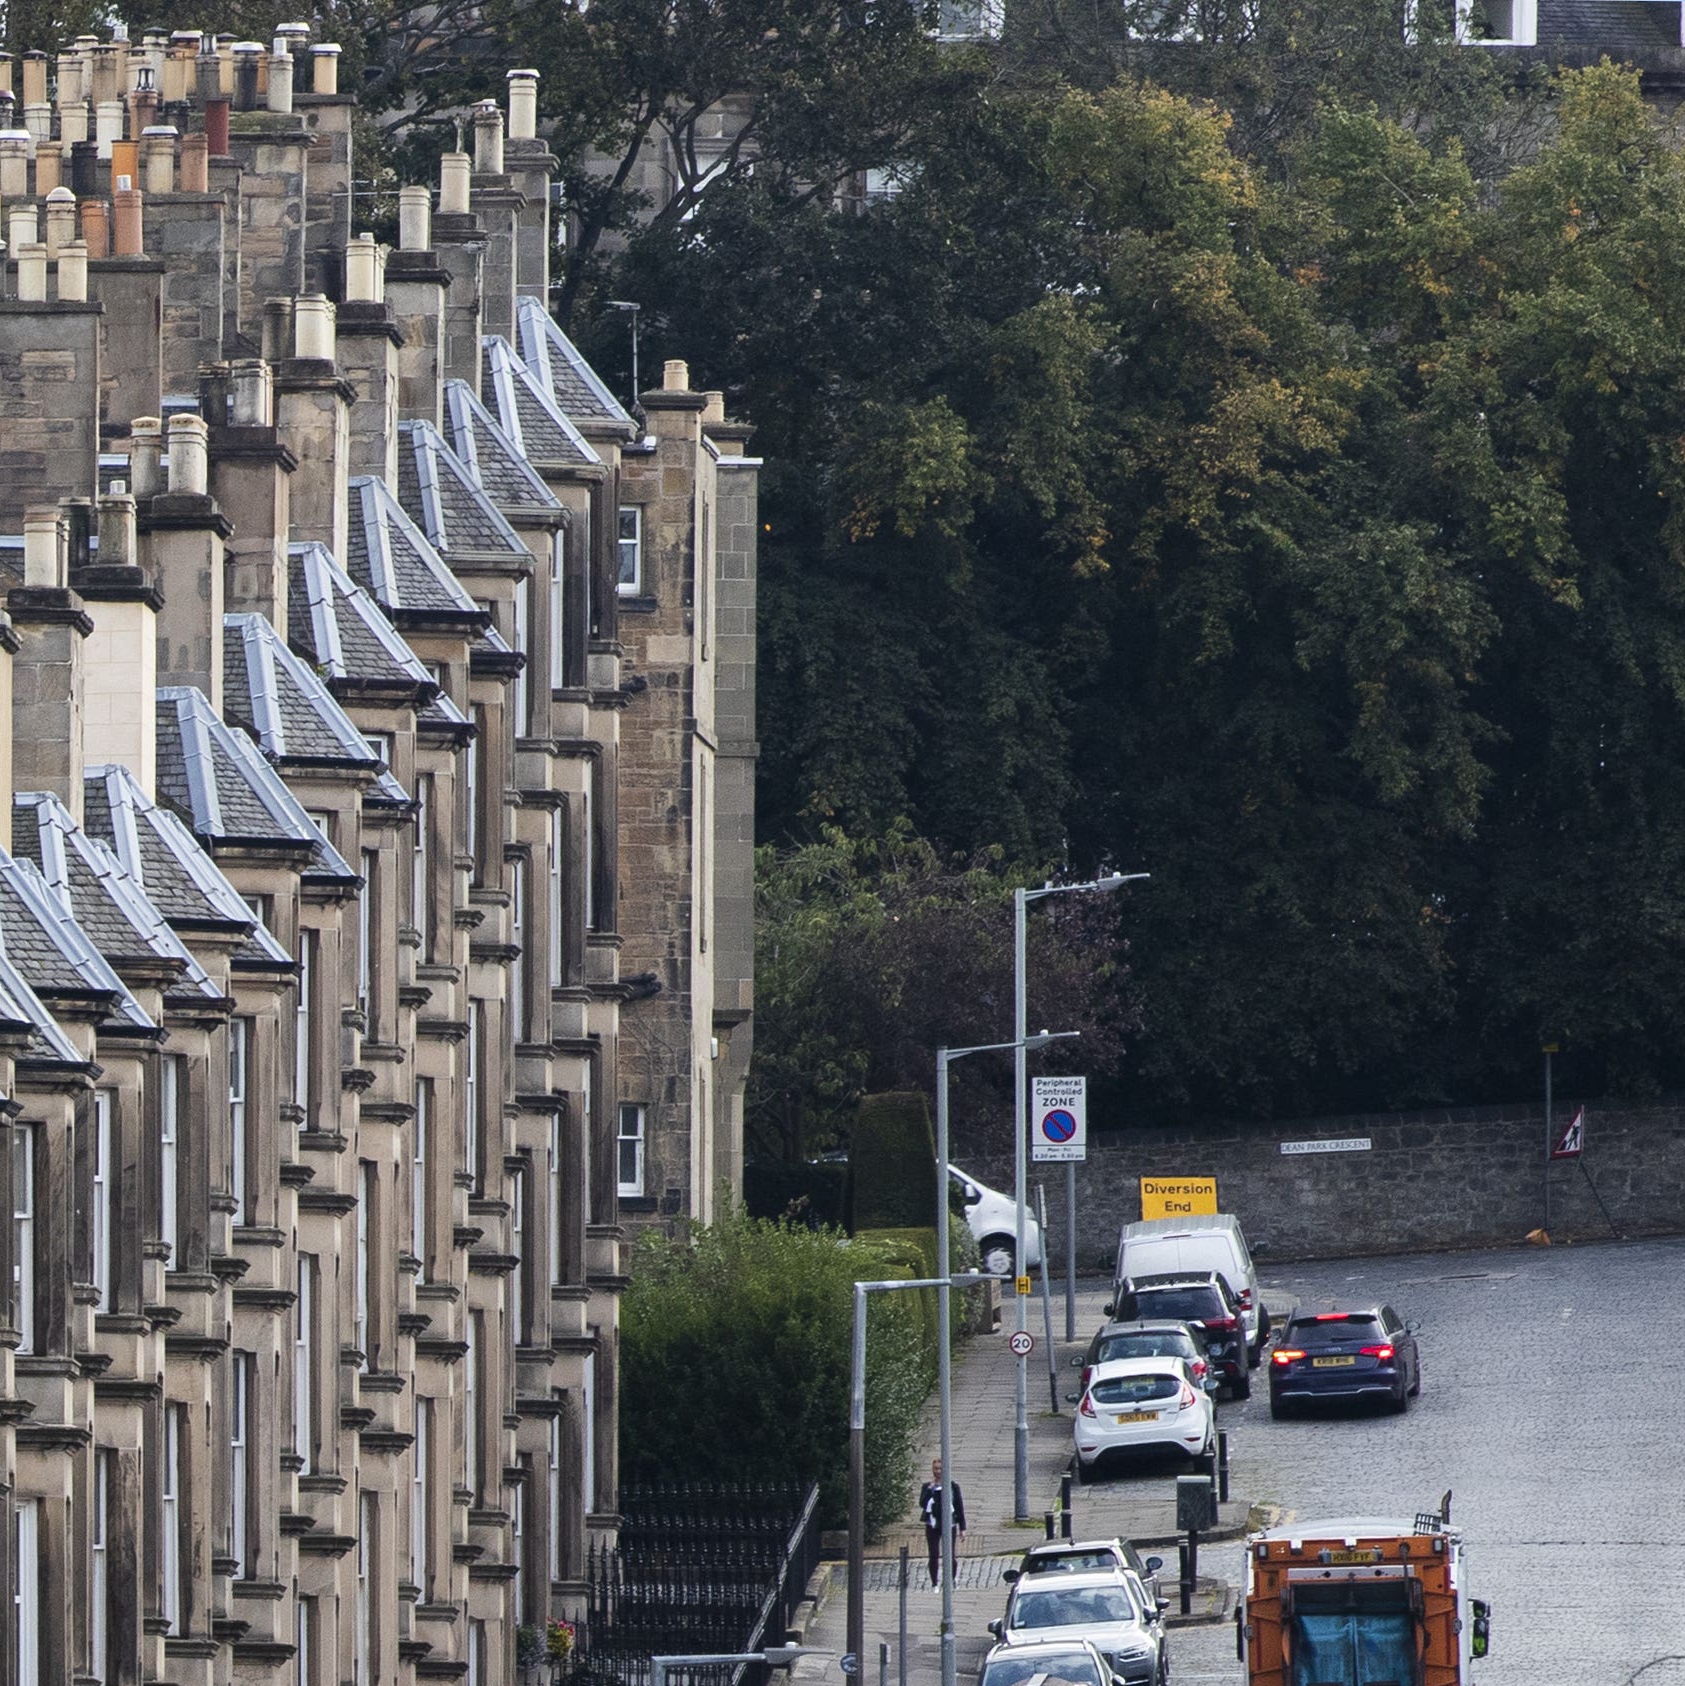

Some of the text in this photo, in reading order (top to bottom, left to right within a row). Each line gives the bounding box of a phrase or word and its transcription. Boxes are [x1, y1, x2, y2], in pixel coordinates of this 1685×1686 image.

[1036, 1088, 1083, 1096] Controlled
[1042, 1097, 1076, 1107] ZONE
[1282, 1139, 1370, 1152] DEAN PARK CRESCENT
[1144, 1183, 1213, 1194] Diversion
[1165, 1200, 1191, 1212] End
[1017, 1277, 1029, 1292] H
[1013, 1338, 1030, 1349] 20
